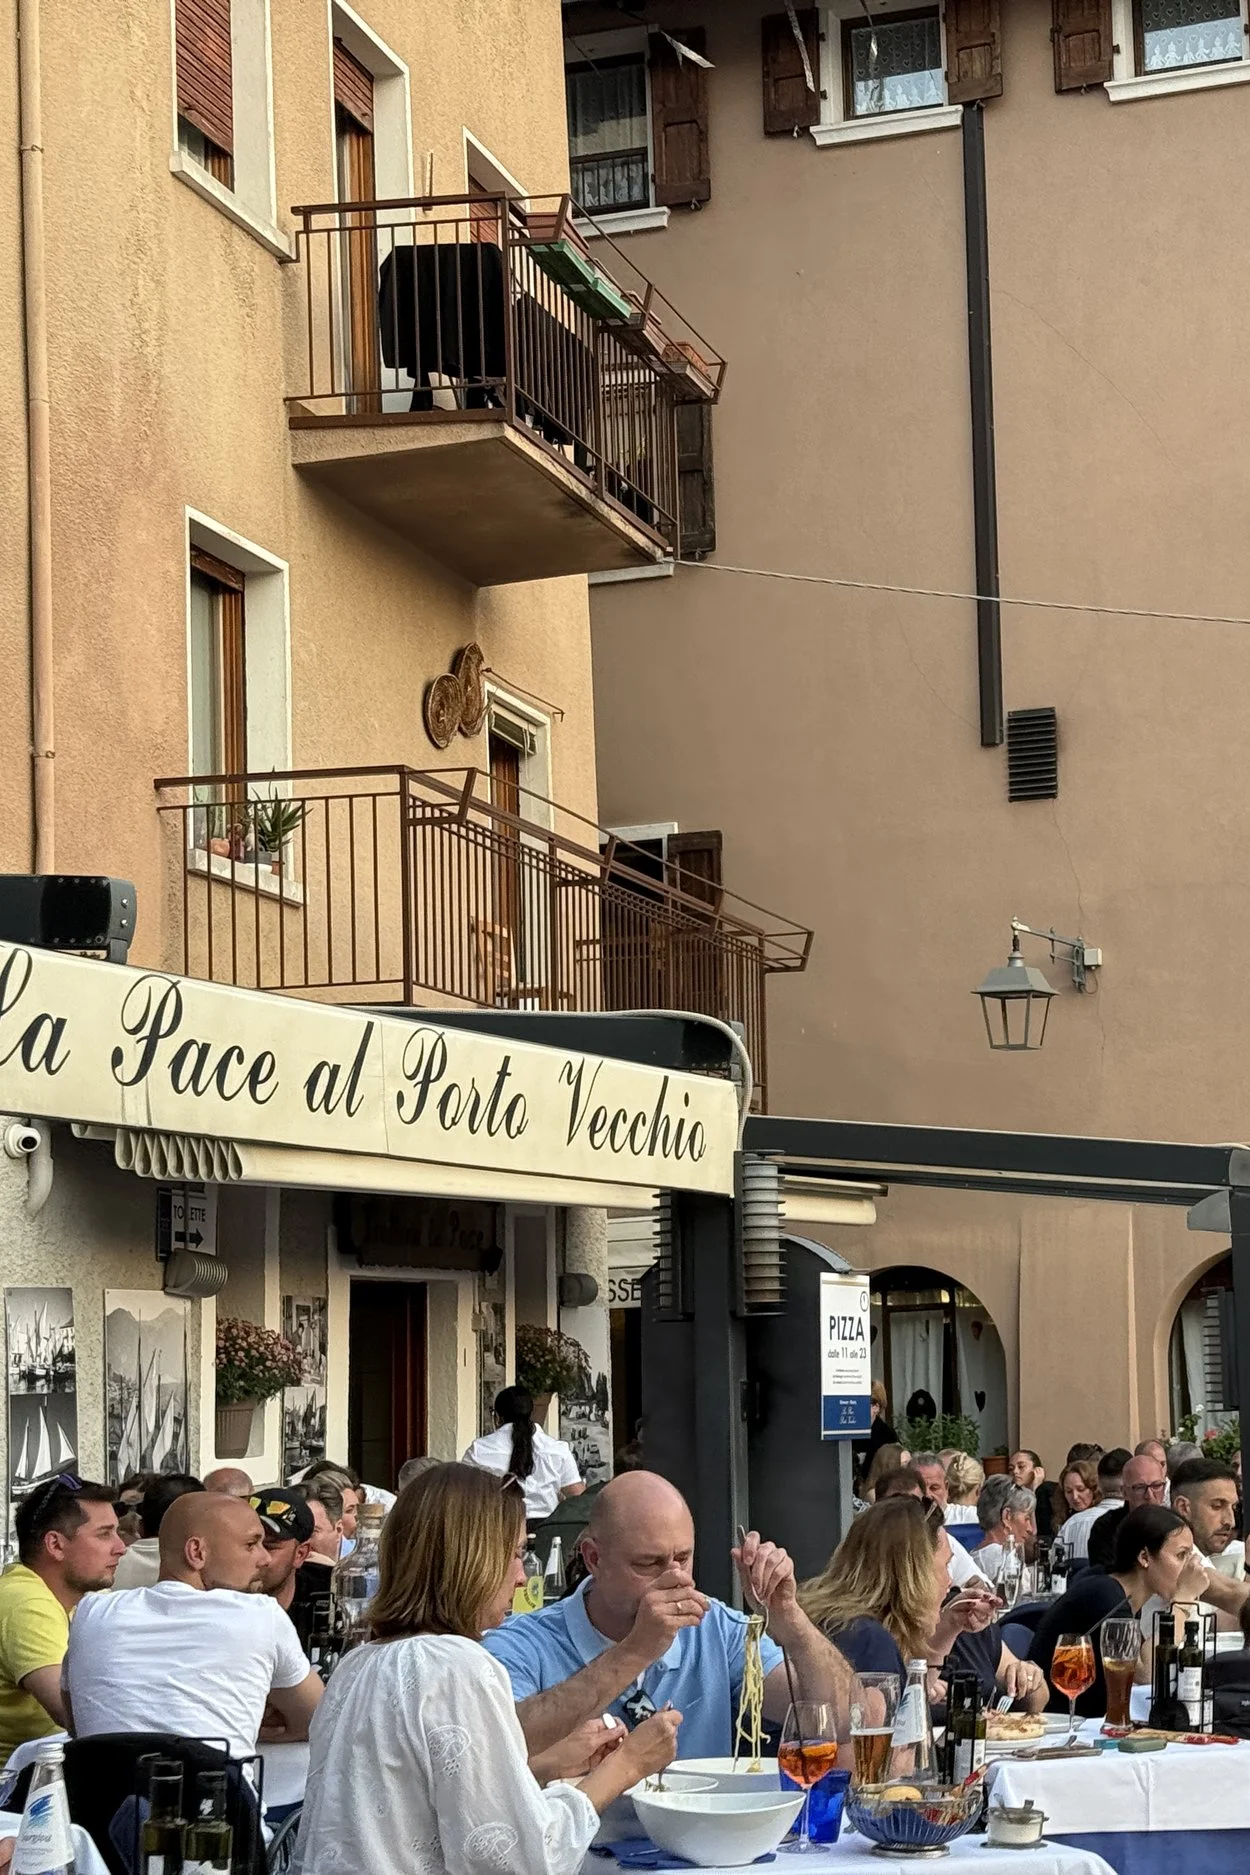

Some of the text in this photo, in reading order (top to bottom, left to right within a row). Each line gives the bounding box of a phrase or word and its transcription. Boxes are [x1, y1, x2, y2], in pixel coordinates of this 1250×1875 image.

[111, 974, 279, 1105] Pace
[303, 1020, 374, 1117] al
[396, 1027, 529, 1140] Porto
[558, 1056, 707, 1162] Vecchio
[173, 1205, 206, 1222] TOETTE
[829, 1315, 865, 1342] PIZZA
[841, 1347, 848, 1359] 11
[860, 1347, 867, 1359] 23
